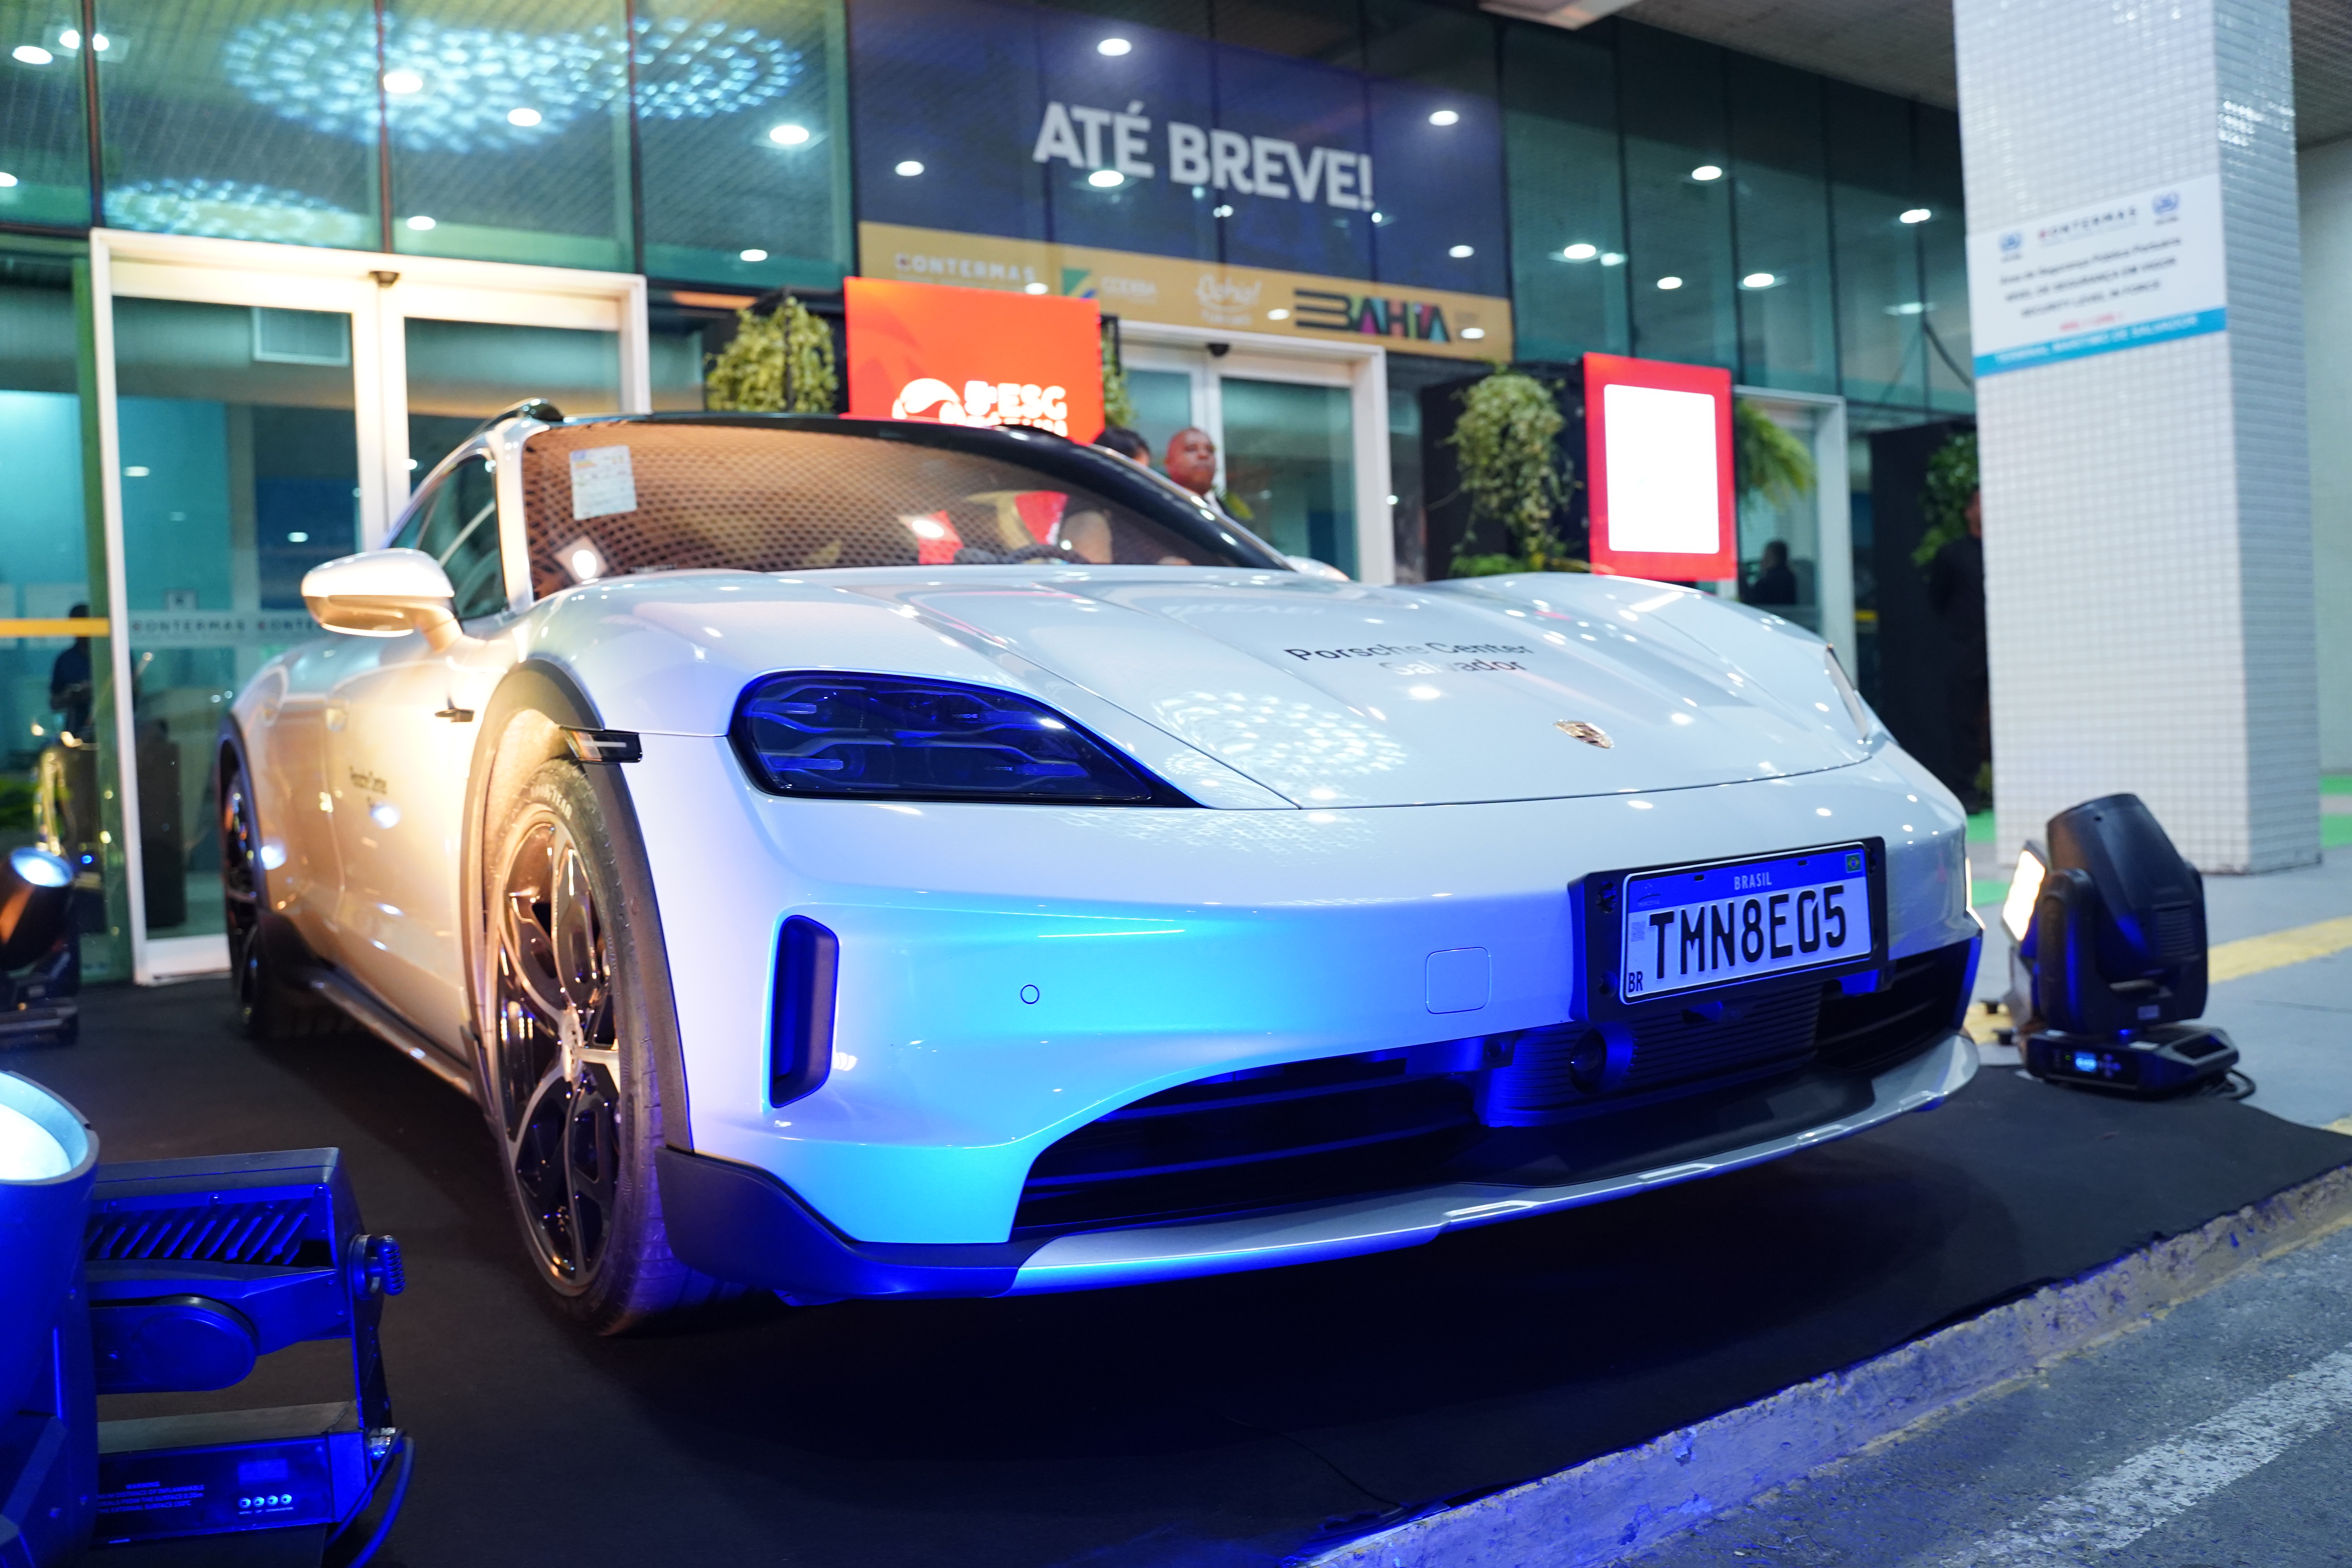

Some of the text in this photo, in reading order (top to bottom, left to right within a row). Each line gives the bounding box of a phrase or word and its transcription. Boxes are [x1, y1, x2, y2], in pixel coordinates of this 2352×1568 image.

[1033, 100, 1375, 212] ATÉ BREVE!
[1293, 289, 1450, 343] BAHIA
[1283, 642, 1534, 661] Porsche Center
[1734, 872, 1772, 890] BRASIL
[1649, 885, 1846, 980] TMN8E05
[1628, 971, 1643, 993] BR
